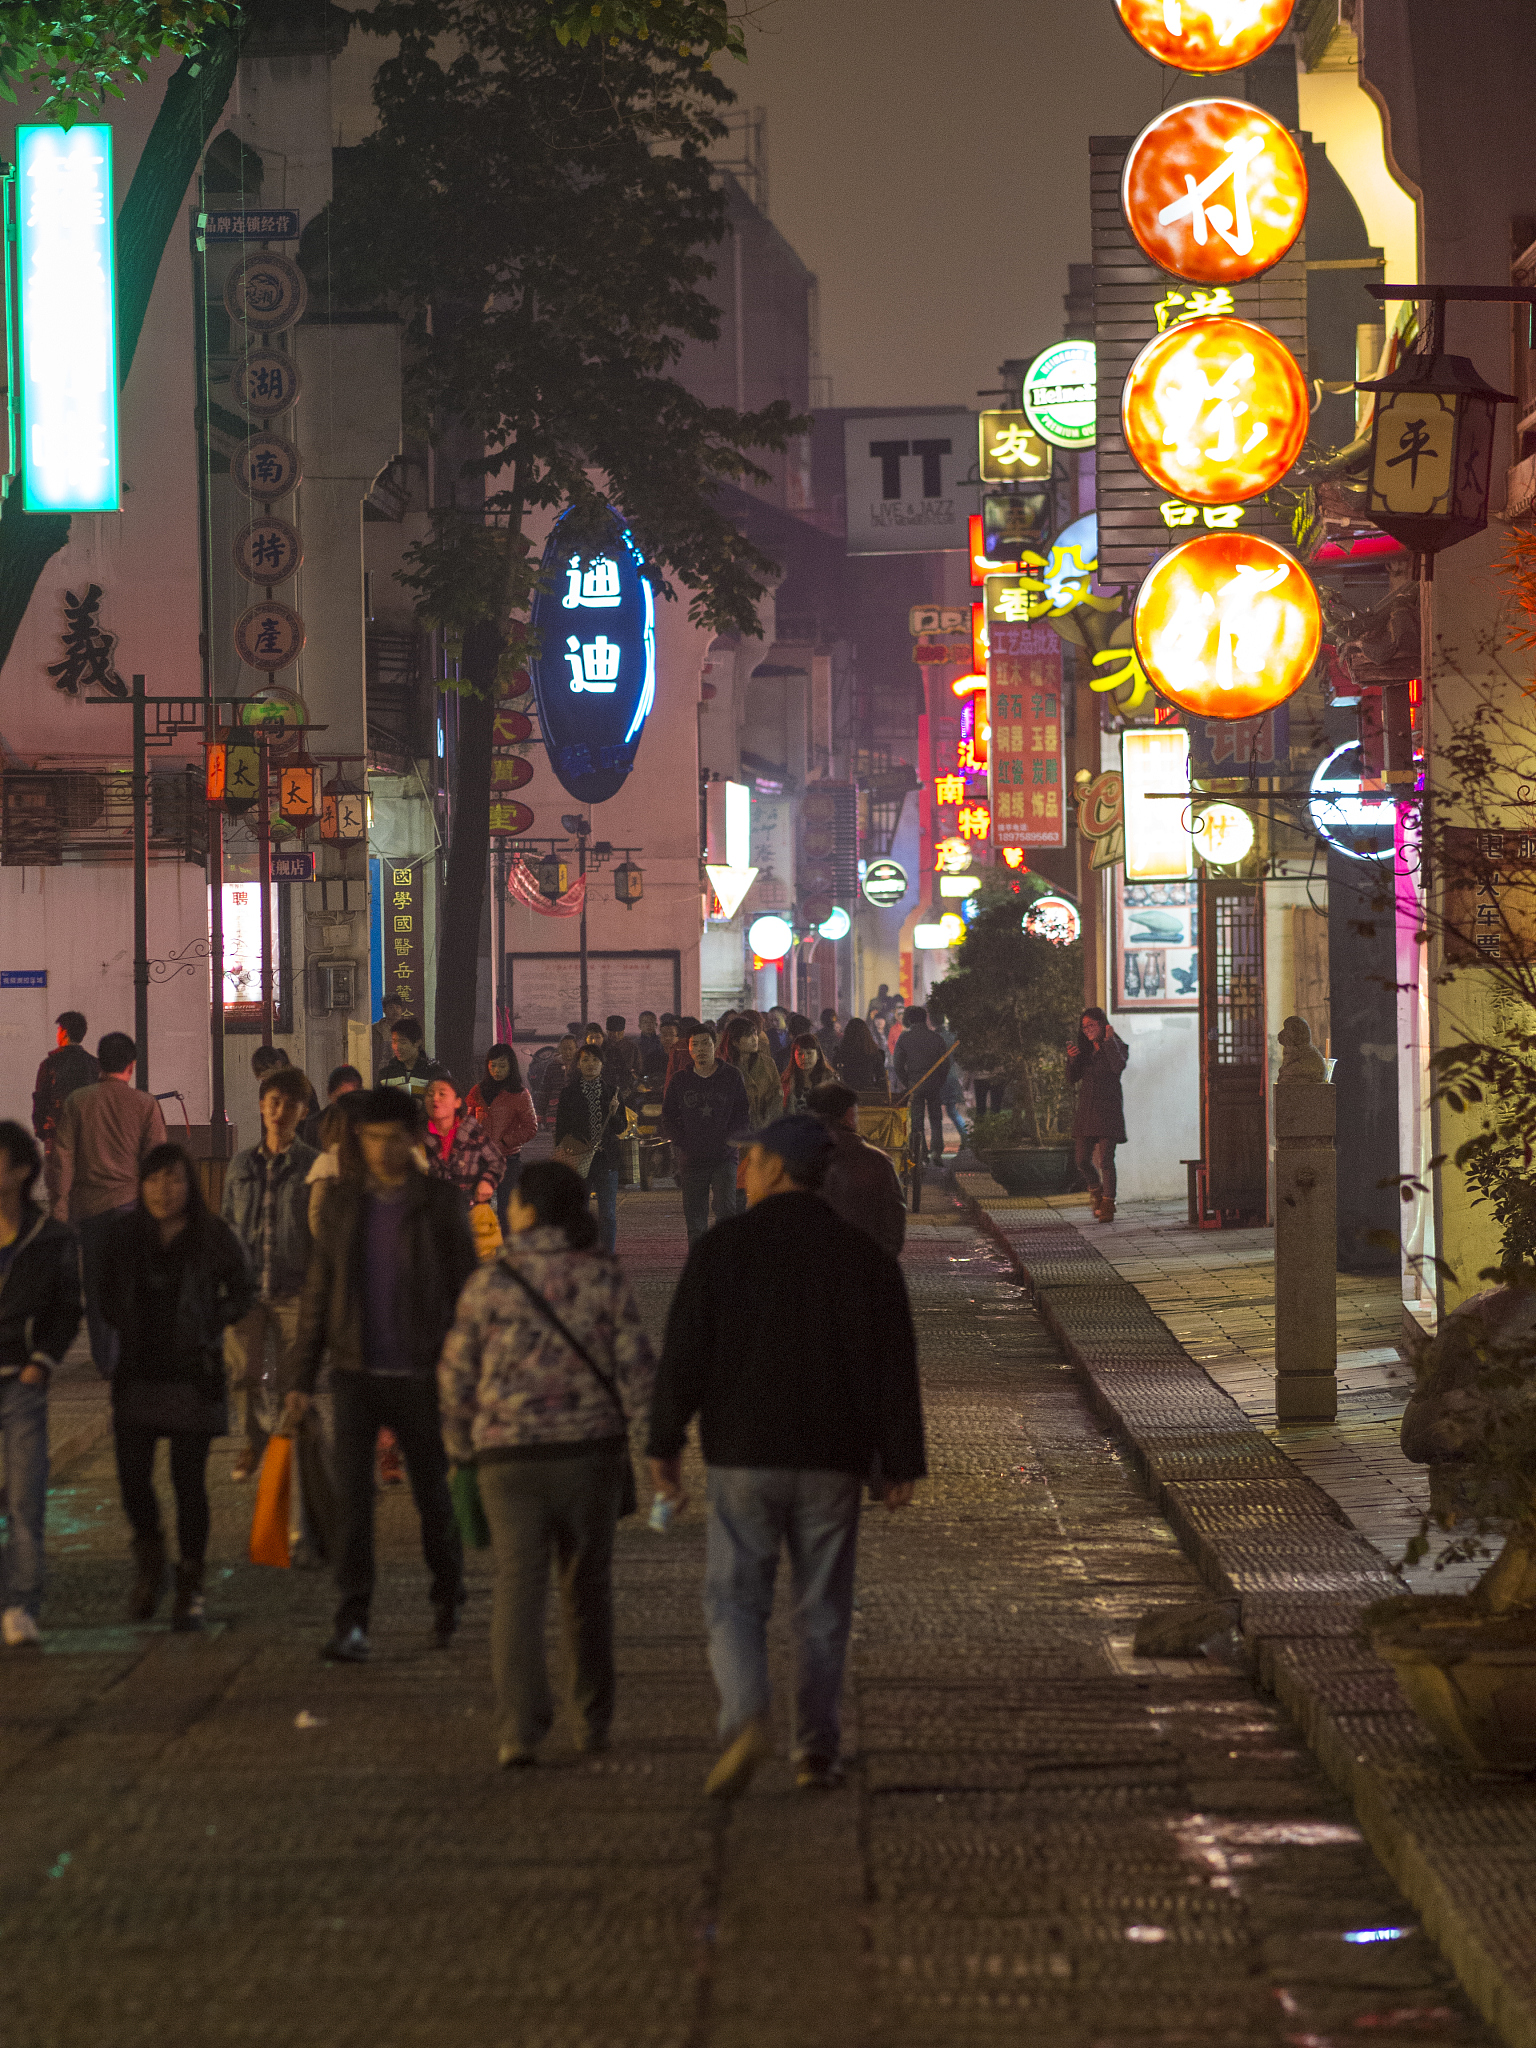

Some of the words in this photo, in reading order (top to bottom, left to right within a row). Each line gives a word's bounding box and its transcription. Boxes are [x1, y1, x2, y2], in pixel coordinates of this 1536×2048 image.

[870, 439, 952, 501] TT
[1386, 419, 1438, 489] 平
[47, 582, 129, 698] 義
[562, 553, 621, 694] 迪迪
[232, 759, 255, 786] 太
[285, 781, 308, 804] 太
[343, 806, 360, 828] 太
